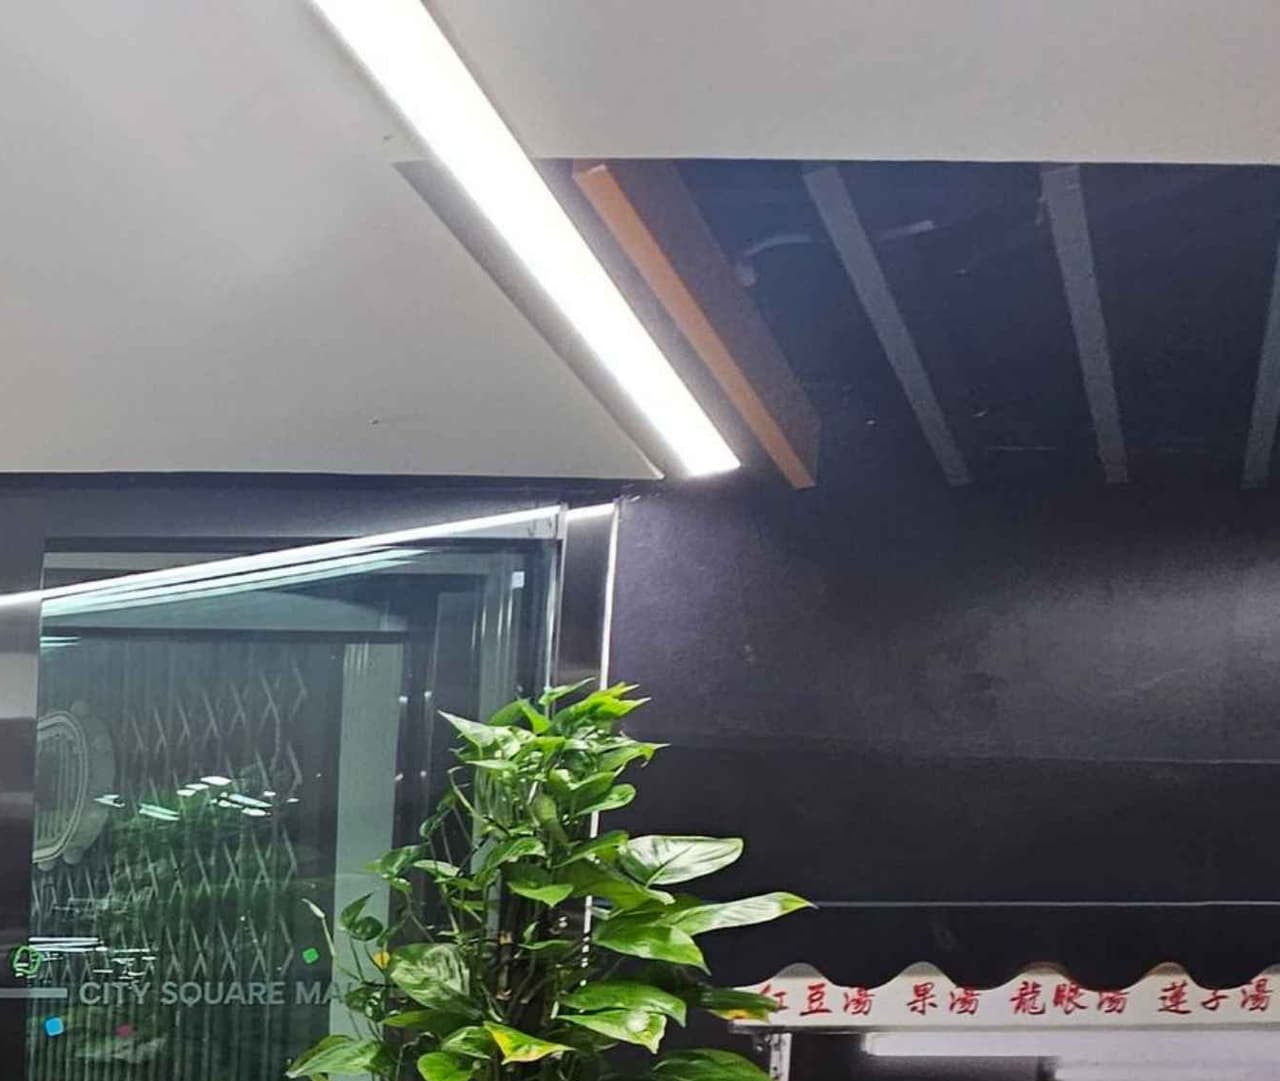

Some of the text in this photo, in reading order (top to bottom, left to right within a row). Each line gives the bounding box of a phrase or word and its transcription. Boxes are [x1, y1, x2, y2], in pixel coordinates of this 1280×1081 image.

[78, 980, 353, 1008] CITY SQUARE MA
